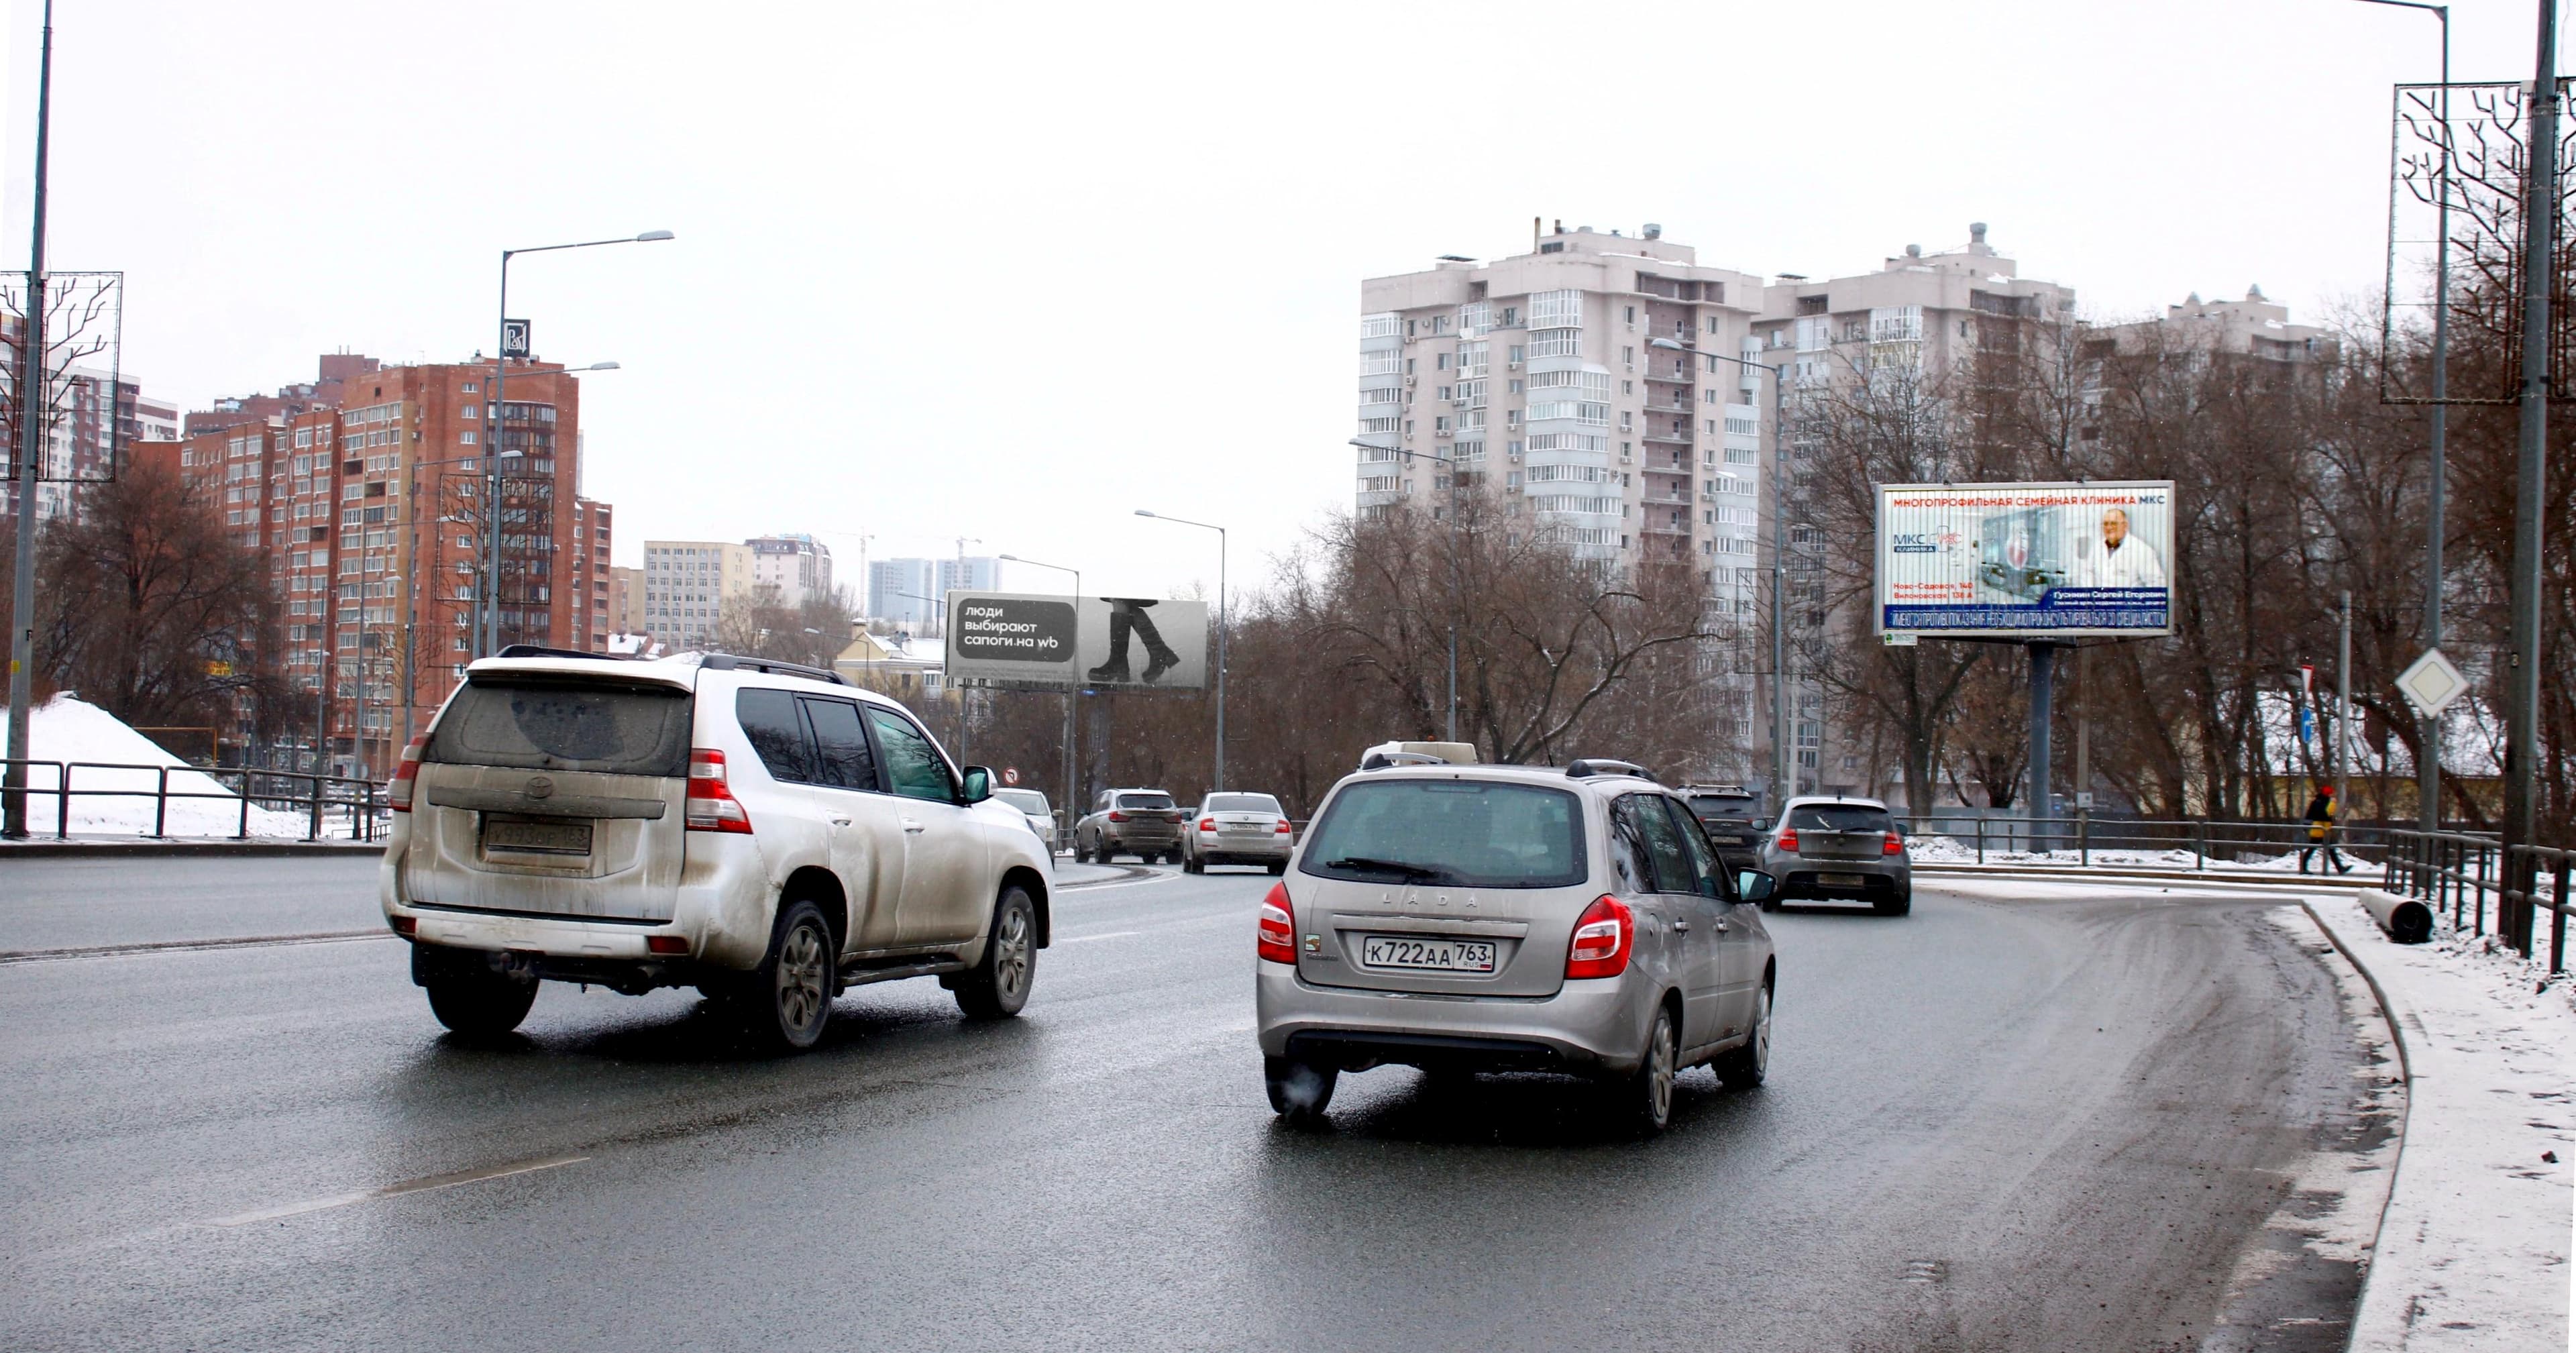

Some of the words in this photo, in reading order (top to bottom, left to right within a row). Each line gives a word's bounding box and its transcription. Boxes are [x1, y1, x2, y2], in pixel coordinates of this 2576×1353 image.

[1894, 498, 2012, 507] МНОГОПРОФИЛЬНАЯ
[2017, 495, 2078, 506] СЕМЕЙНАЯ
[2082, 496, 2136, 505] КЛИНИКА
[2139, 495, 2165, 504] МКС
[1894, 534, 1925, 544] МКС
[965, 607, 1004, 618] люди
[965, 619, 1037, 634] выбирают
[1016, 638, 1034, 647] на
[1037, 636, 1058, 648] wb
[1383, 893, 1477, 908] LADA
[1456, 944, 1487, 961] 763
